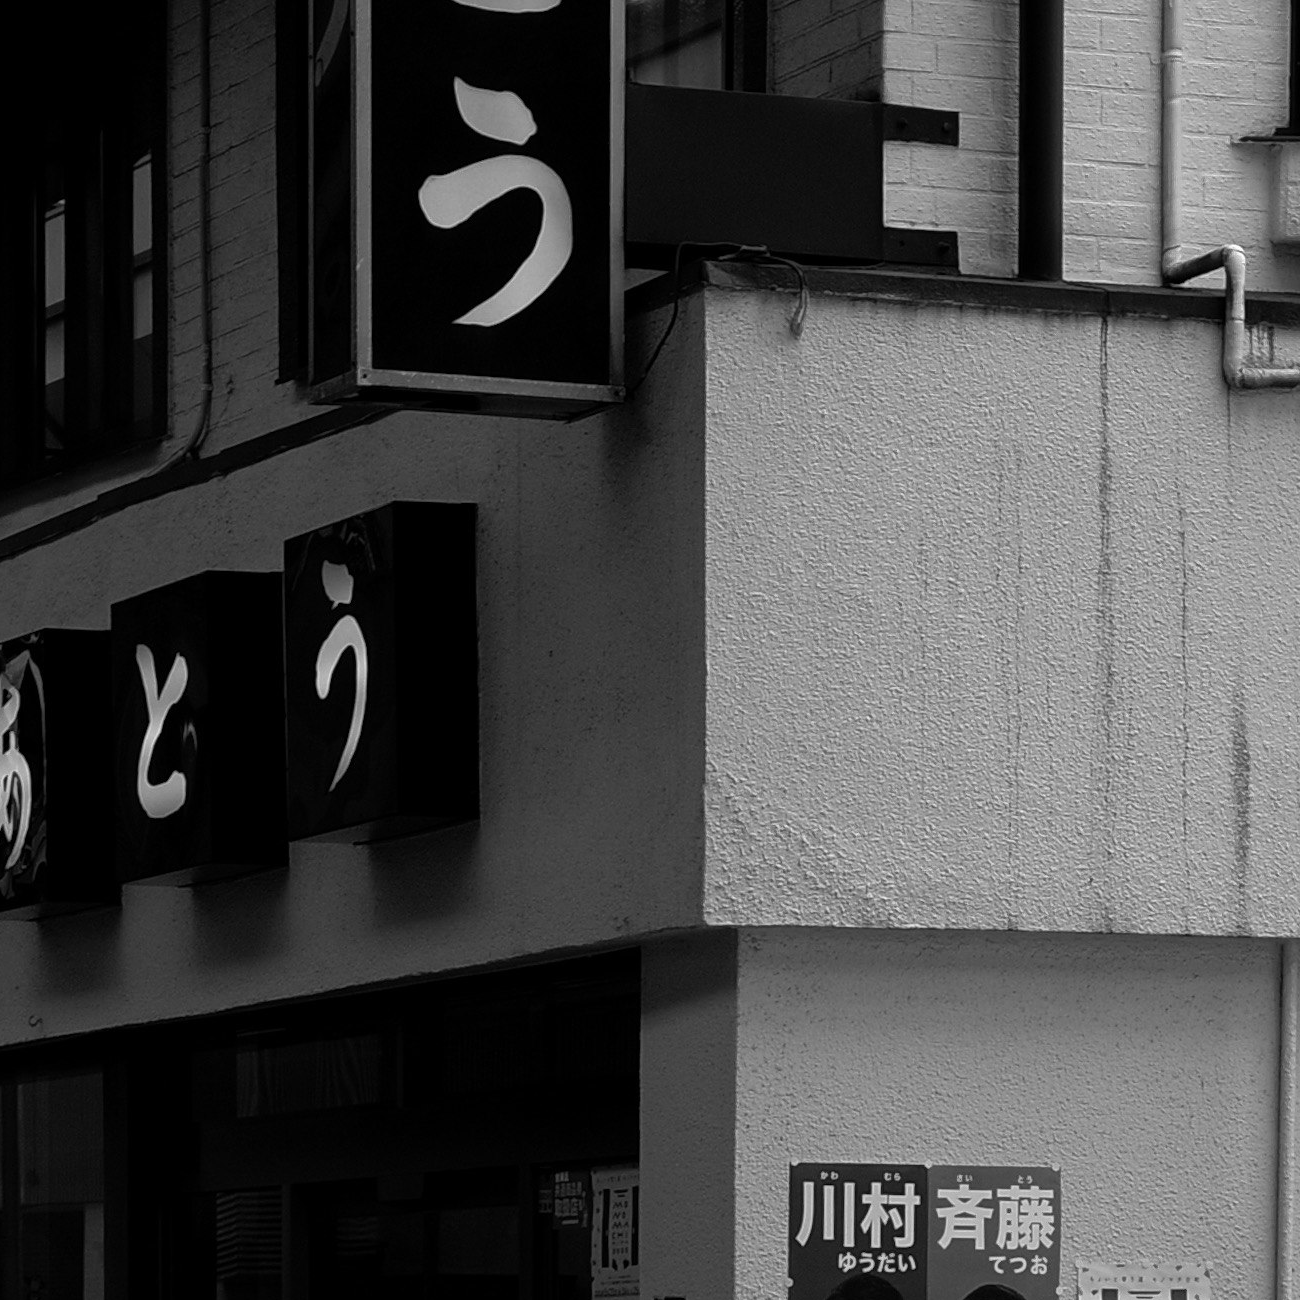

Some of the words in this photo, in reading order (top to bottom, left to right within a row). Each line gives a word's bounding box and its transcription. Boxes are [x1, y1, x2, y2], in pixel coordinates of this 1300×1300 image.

[419, 0, 572, 327] う
[820, 1170, 839, 1181] かわ
[883, 1172, 902, 1182] むら
[956, 1174, 973, 1183] さい
[1017, 1175, 1034, 1184] とう
[795, 1181, 922, 1249] 川村
[936, 1184, 1056, 1250] 斉藤
[837, 1251, 917, 1274] ゆうだい
[988, 1254, 1049, 1275] てつお
